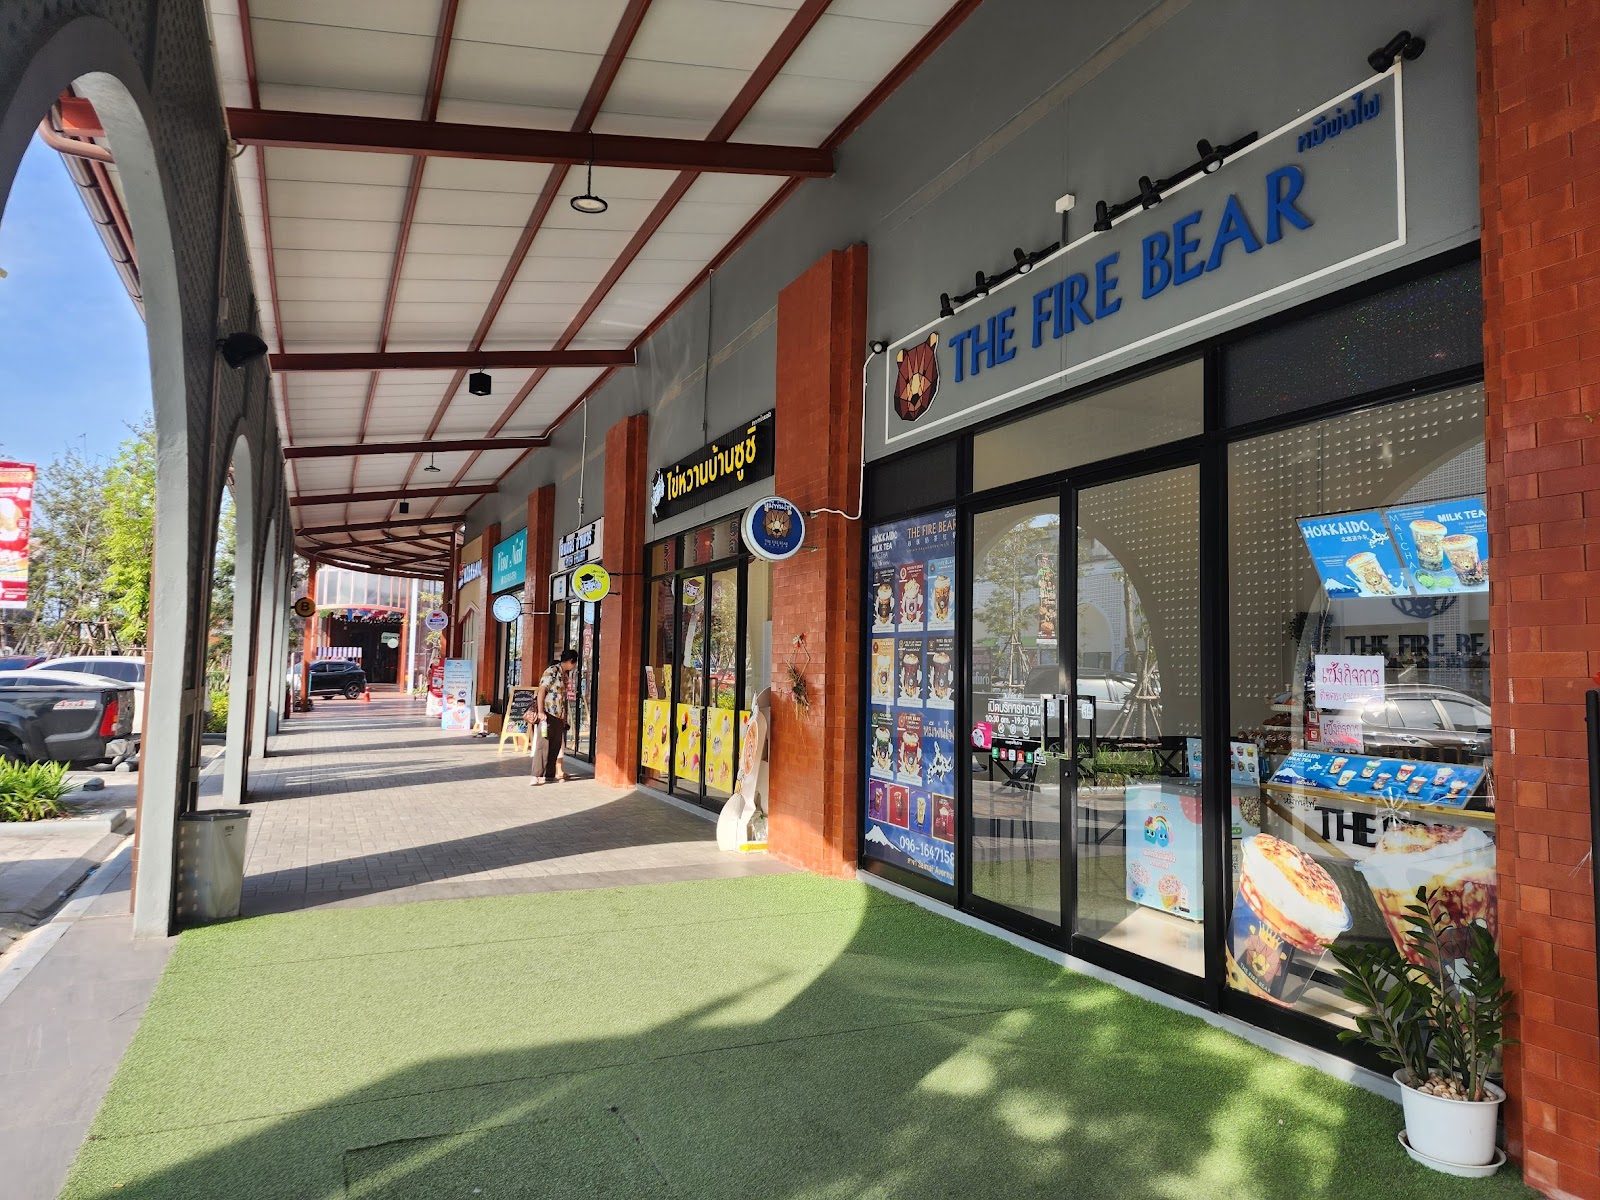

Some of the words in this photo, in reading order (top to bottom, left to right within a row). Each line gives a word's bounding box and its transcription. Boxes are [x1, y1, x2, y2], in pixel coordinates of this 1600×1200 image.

[1297, 92, 1380, 153] หมีพ่นไฟ
[949, 307, 1016, 382] THE
[1032, 252, 1122, 348] FIRE
[1142, 165, 1314, 299] BEAR
[667, 426, 756, 500] ไข่หวานบ้านซูชิ
[1437, 512, 1463, 522] MILK
[1463, 509, 1487, 519] TEA
[907, 526, 920, 539] THE
[922, 522, 937, 536] FIRE
[1303, 520, 1370, 539] HOKKAIDO
[883, 541, 893, 552] TEA
[1389, 514, 1417, 569] MATCHA
[301, 601, 310, 611] B
[1345, 634, 1389, 656] THE
[1398, 634, 1445, 656] FIRE
[1322, 661, 1380, 686] เซ้งกิจการ
[987, 701, 1041, 717] เปิดบริการทุกวัน
[985, 714, 1000, 723] 10:30
[1030, 719, 1041, 727] pm.
[1292, 751, 1321, 760] HOKKAIDO
[1314, 806, 1377, 848] THE
[1240, 962, 1248, 974] THE
